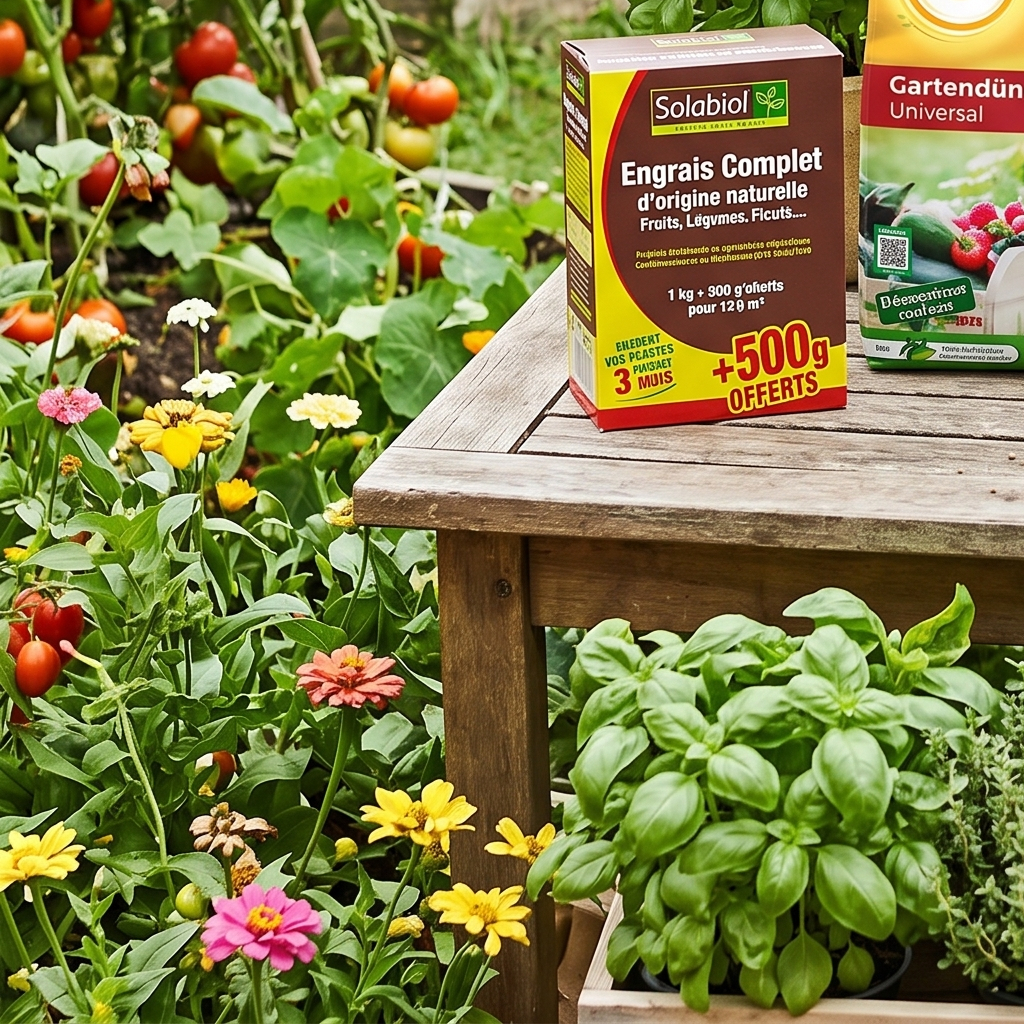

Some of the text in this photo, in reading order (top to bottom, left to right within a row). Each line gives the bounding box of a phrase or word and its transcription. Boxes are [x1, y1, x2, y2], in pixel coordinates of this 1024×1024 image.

[655, 89, 748, 120] Solabiol
[890, 102, 983, 123] Universal
[621, 147, 823, 190] Engrais Complet
[726, 180, 809, 205] naturelle
[667, 288, 675, 301] 1
[678, 287, 694, 302] kg
[697, 289, 704, 298] +
[688, 303, 717, 318] pour
[604, 354, 626, 367] VOS
[712, 323, 829, 384] +500g
[614, 367, 632, 395] 3
[729, 371, 818, 412] OFFERTS
